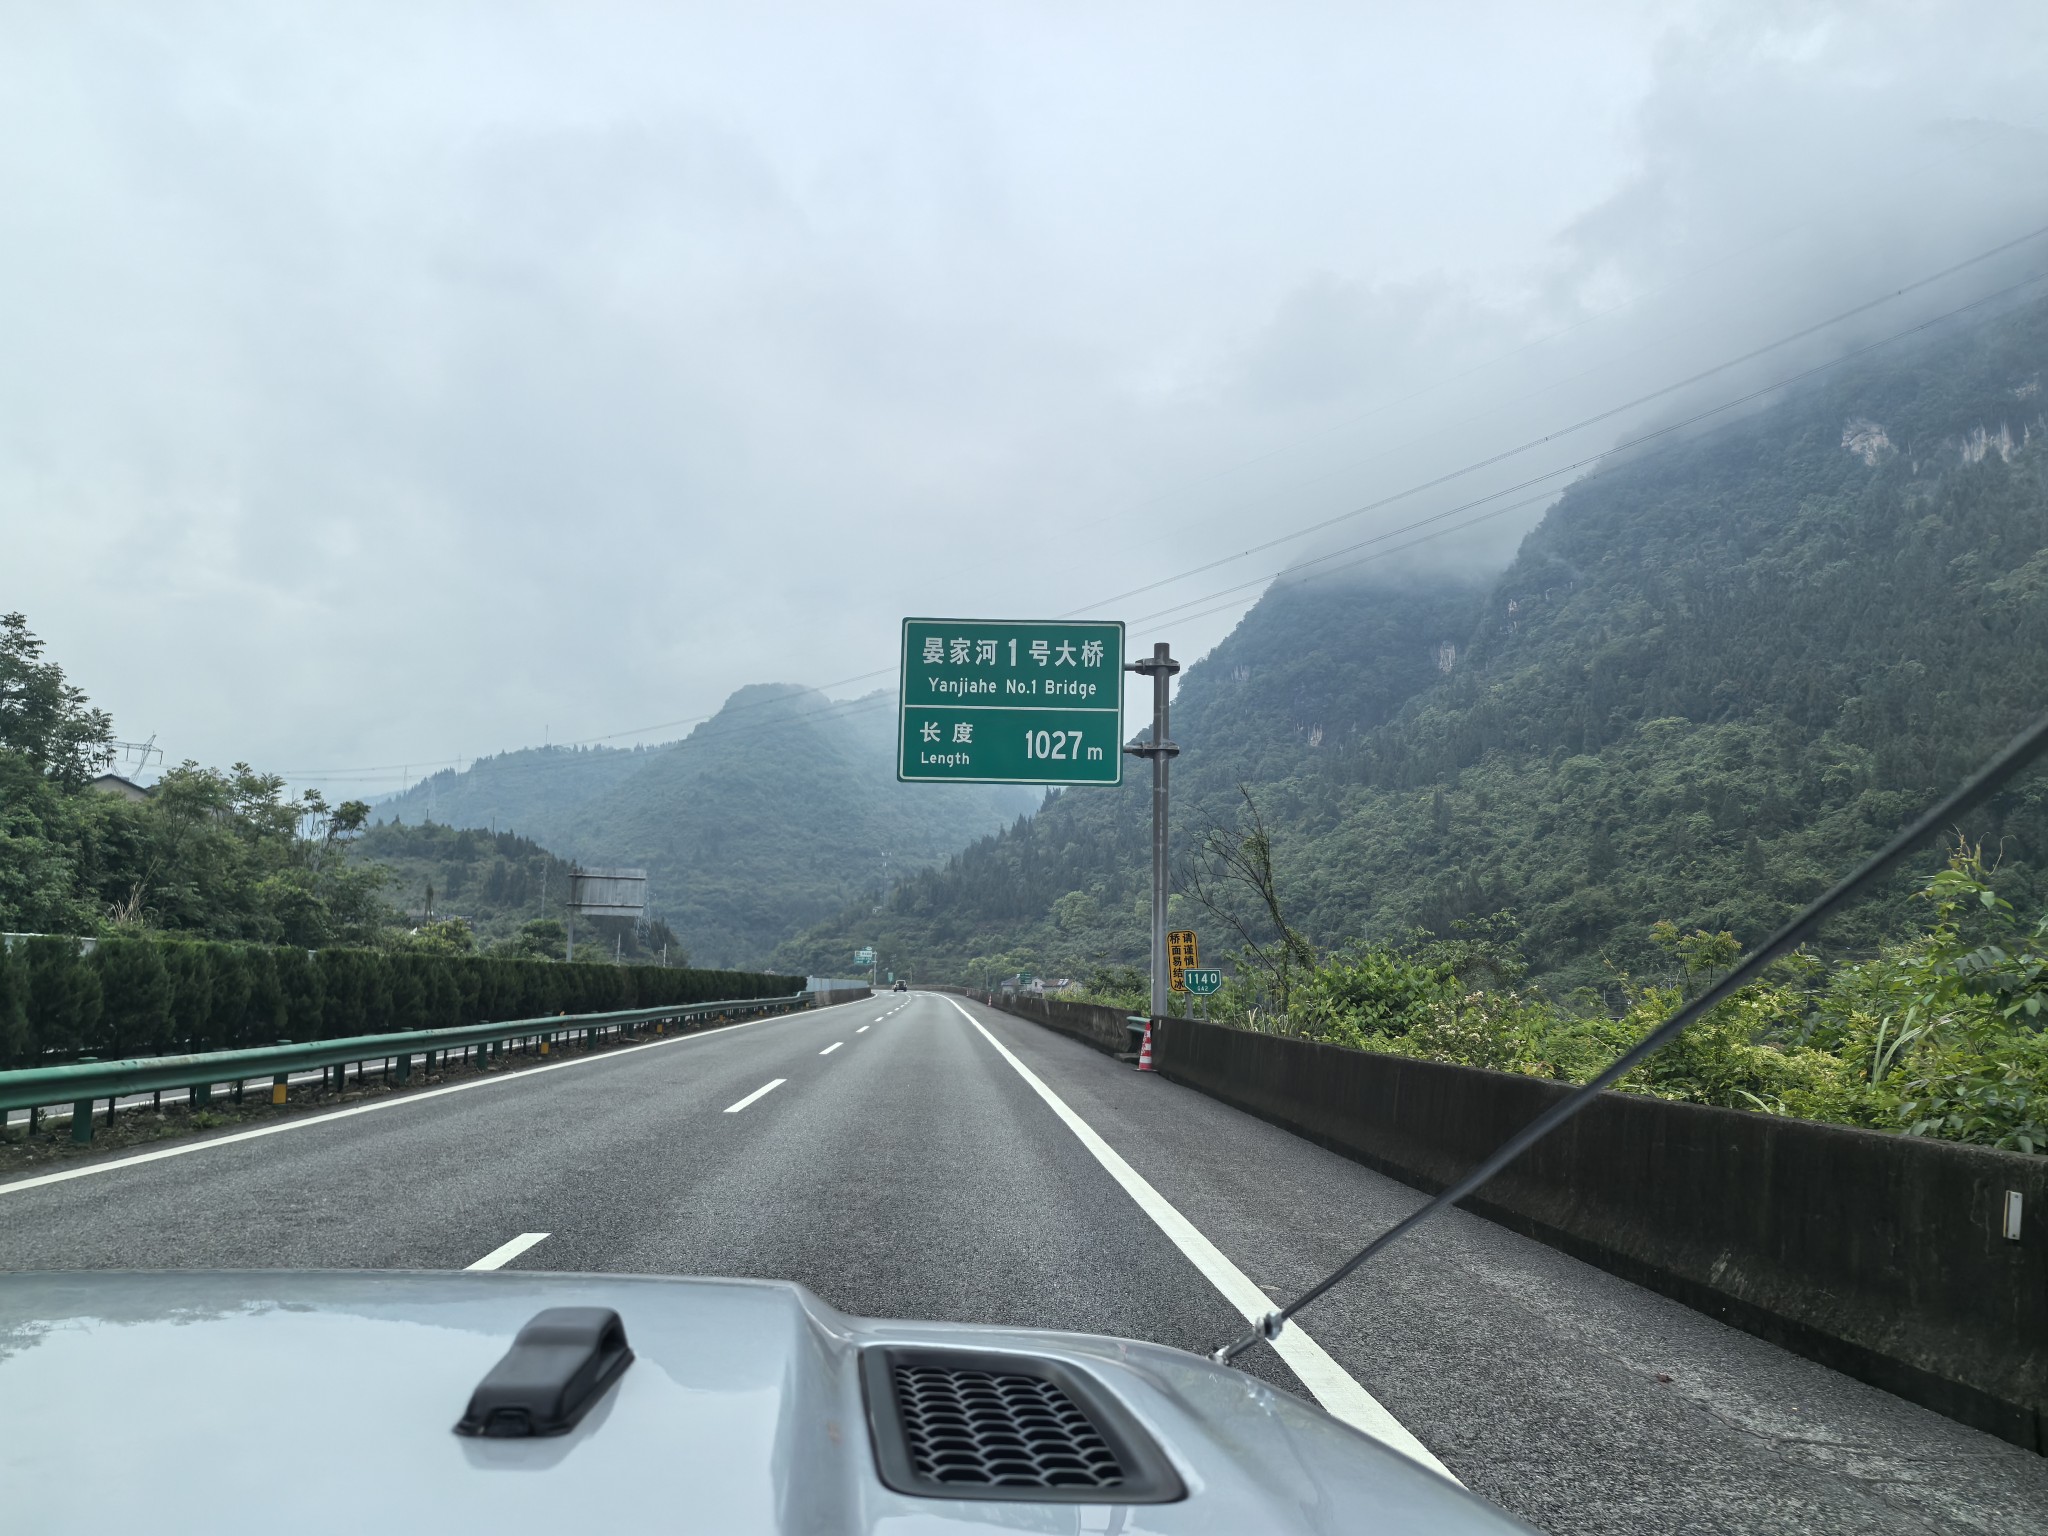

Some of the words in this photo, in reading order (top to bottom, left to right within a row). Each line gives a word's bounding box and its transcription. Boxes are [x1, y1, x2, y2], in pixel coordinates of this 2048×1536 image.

[928, 677, 997, 697] Yanjiahe
[1006, 679, 1037, 694] No.1
[1045, 680, 1097, 699] Bridge
[919, 722, 974, 744] 长度
[1025, 730, 1083, 760] 1027
[1087, 746, 1103, 761] m
[921, 752, 970, 767] Length
[1169, 933, 1184, 989] 桥面易结冰
[1182, 933, 1195, 969] 请谨慎
[1188, 973, 1217, 984] 1140
